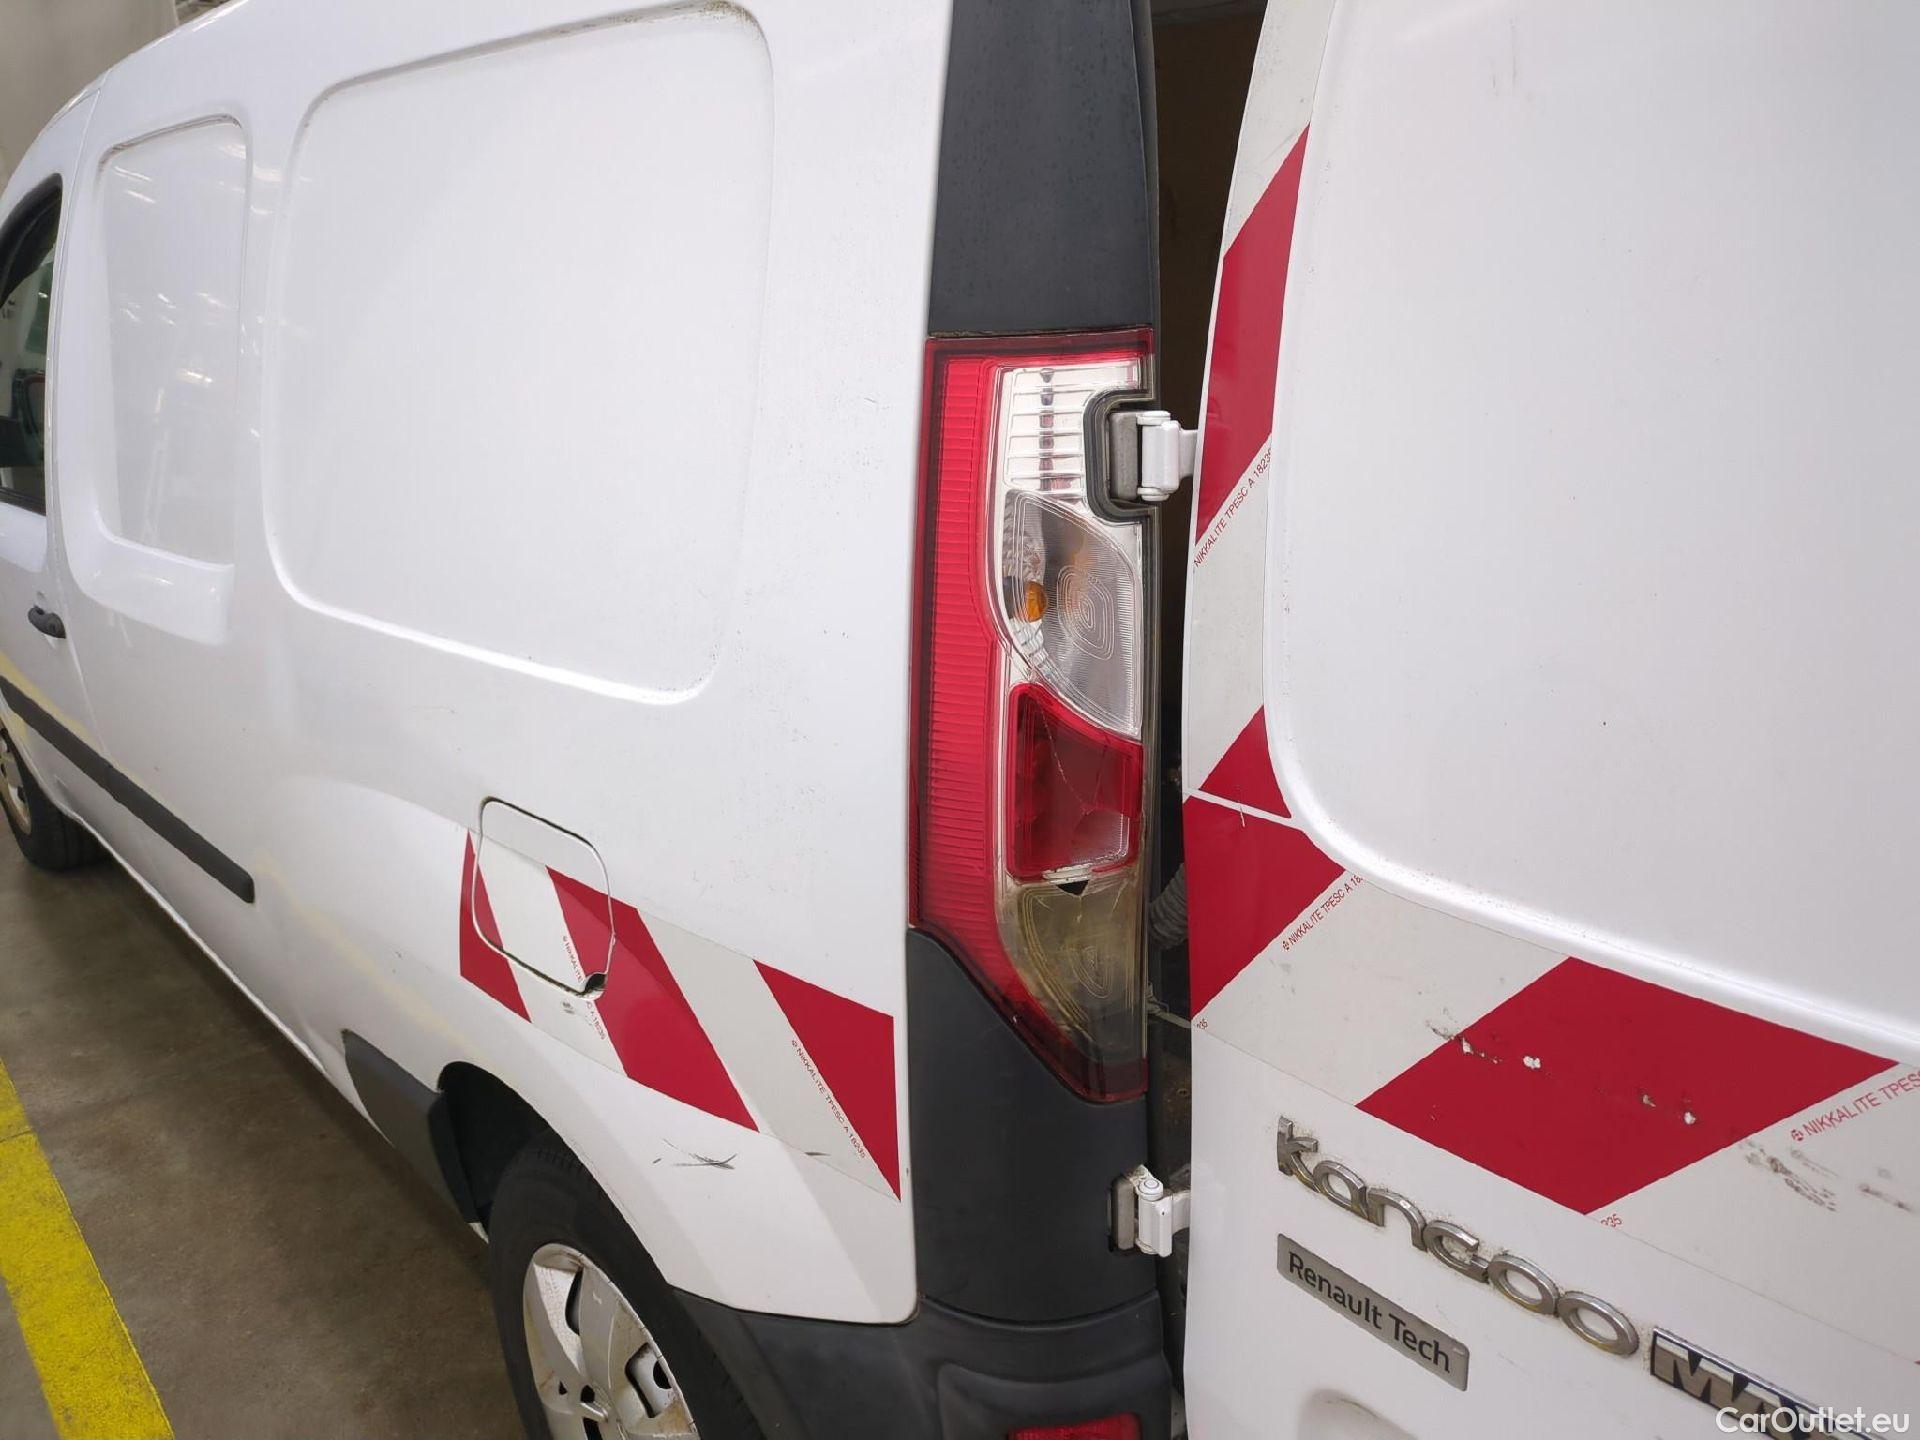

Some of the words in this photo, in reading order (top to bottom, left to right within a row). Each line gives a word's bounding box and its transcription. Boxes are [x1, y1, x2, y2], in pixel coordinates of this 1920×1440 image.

[1193, 518, 1227, 567] NIKKALITE
[1224, 486, 1249, 519] TPESC
[1288, 909, 1324, 946] NIKKALITE
[1321, 888, 1345, 914] TPESC
[797, 1048, 826, 1094] NIKKALITE
[1802, 1092, 1881, 1137] NIKKALITE
[1878, 1071, 1920, 1100] TPES
[1288, 1250, 1383, 1331] Renault
[1389, 1312, 1451, 1374] Tech
